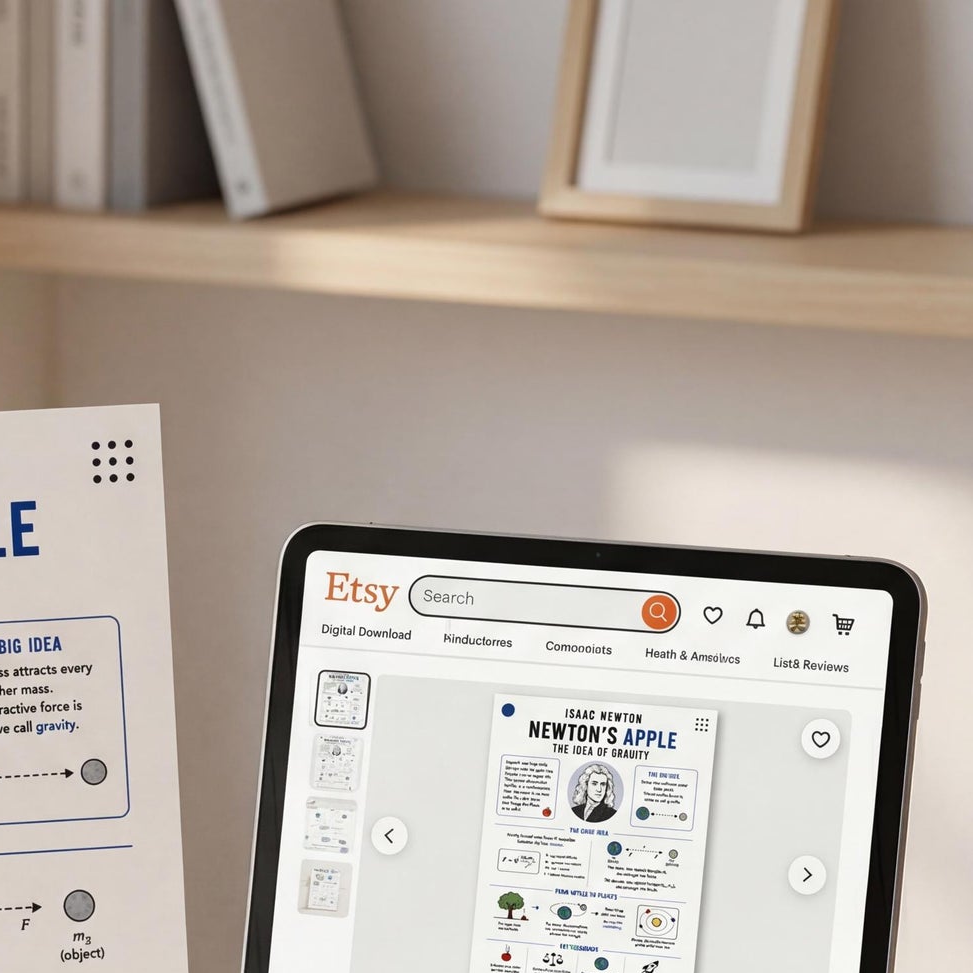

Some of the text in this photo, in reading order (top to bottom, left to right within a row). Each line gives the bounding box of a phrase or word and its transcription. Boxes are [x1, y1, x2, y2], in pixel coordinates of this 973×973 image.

[324, 572, 399, 612] Etsy
[423, 589, 474, 606] Search
[321, 623, 412, 641] Digital Download
[28, 636, 62, 653] IDEA
[645, 647, 688, 661] Heath &
[12, 664, 58, 677] attracts
[60, 664, 93, 676] every
[802, 659, 849, 673] Reviews
[564, 708, 643, 724] ISAAC NEWTON
[13, 719, 33, 734] call
[35, 718, 80, 736] gravity.
[528, 720, 678, 750] NEWTON'S APPLE
[552, 743, 569, 755] THE
[572, 745, 593, 756] IDEA
[596, 746, 609, 757] OF
[21, 919, 30, 930] F
[60, 947, 105, 962] (object)
